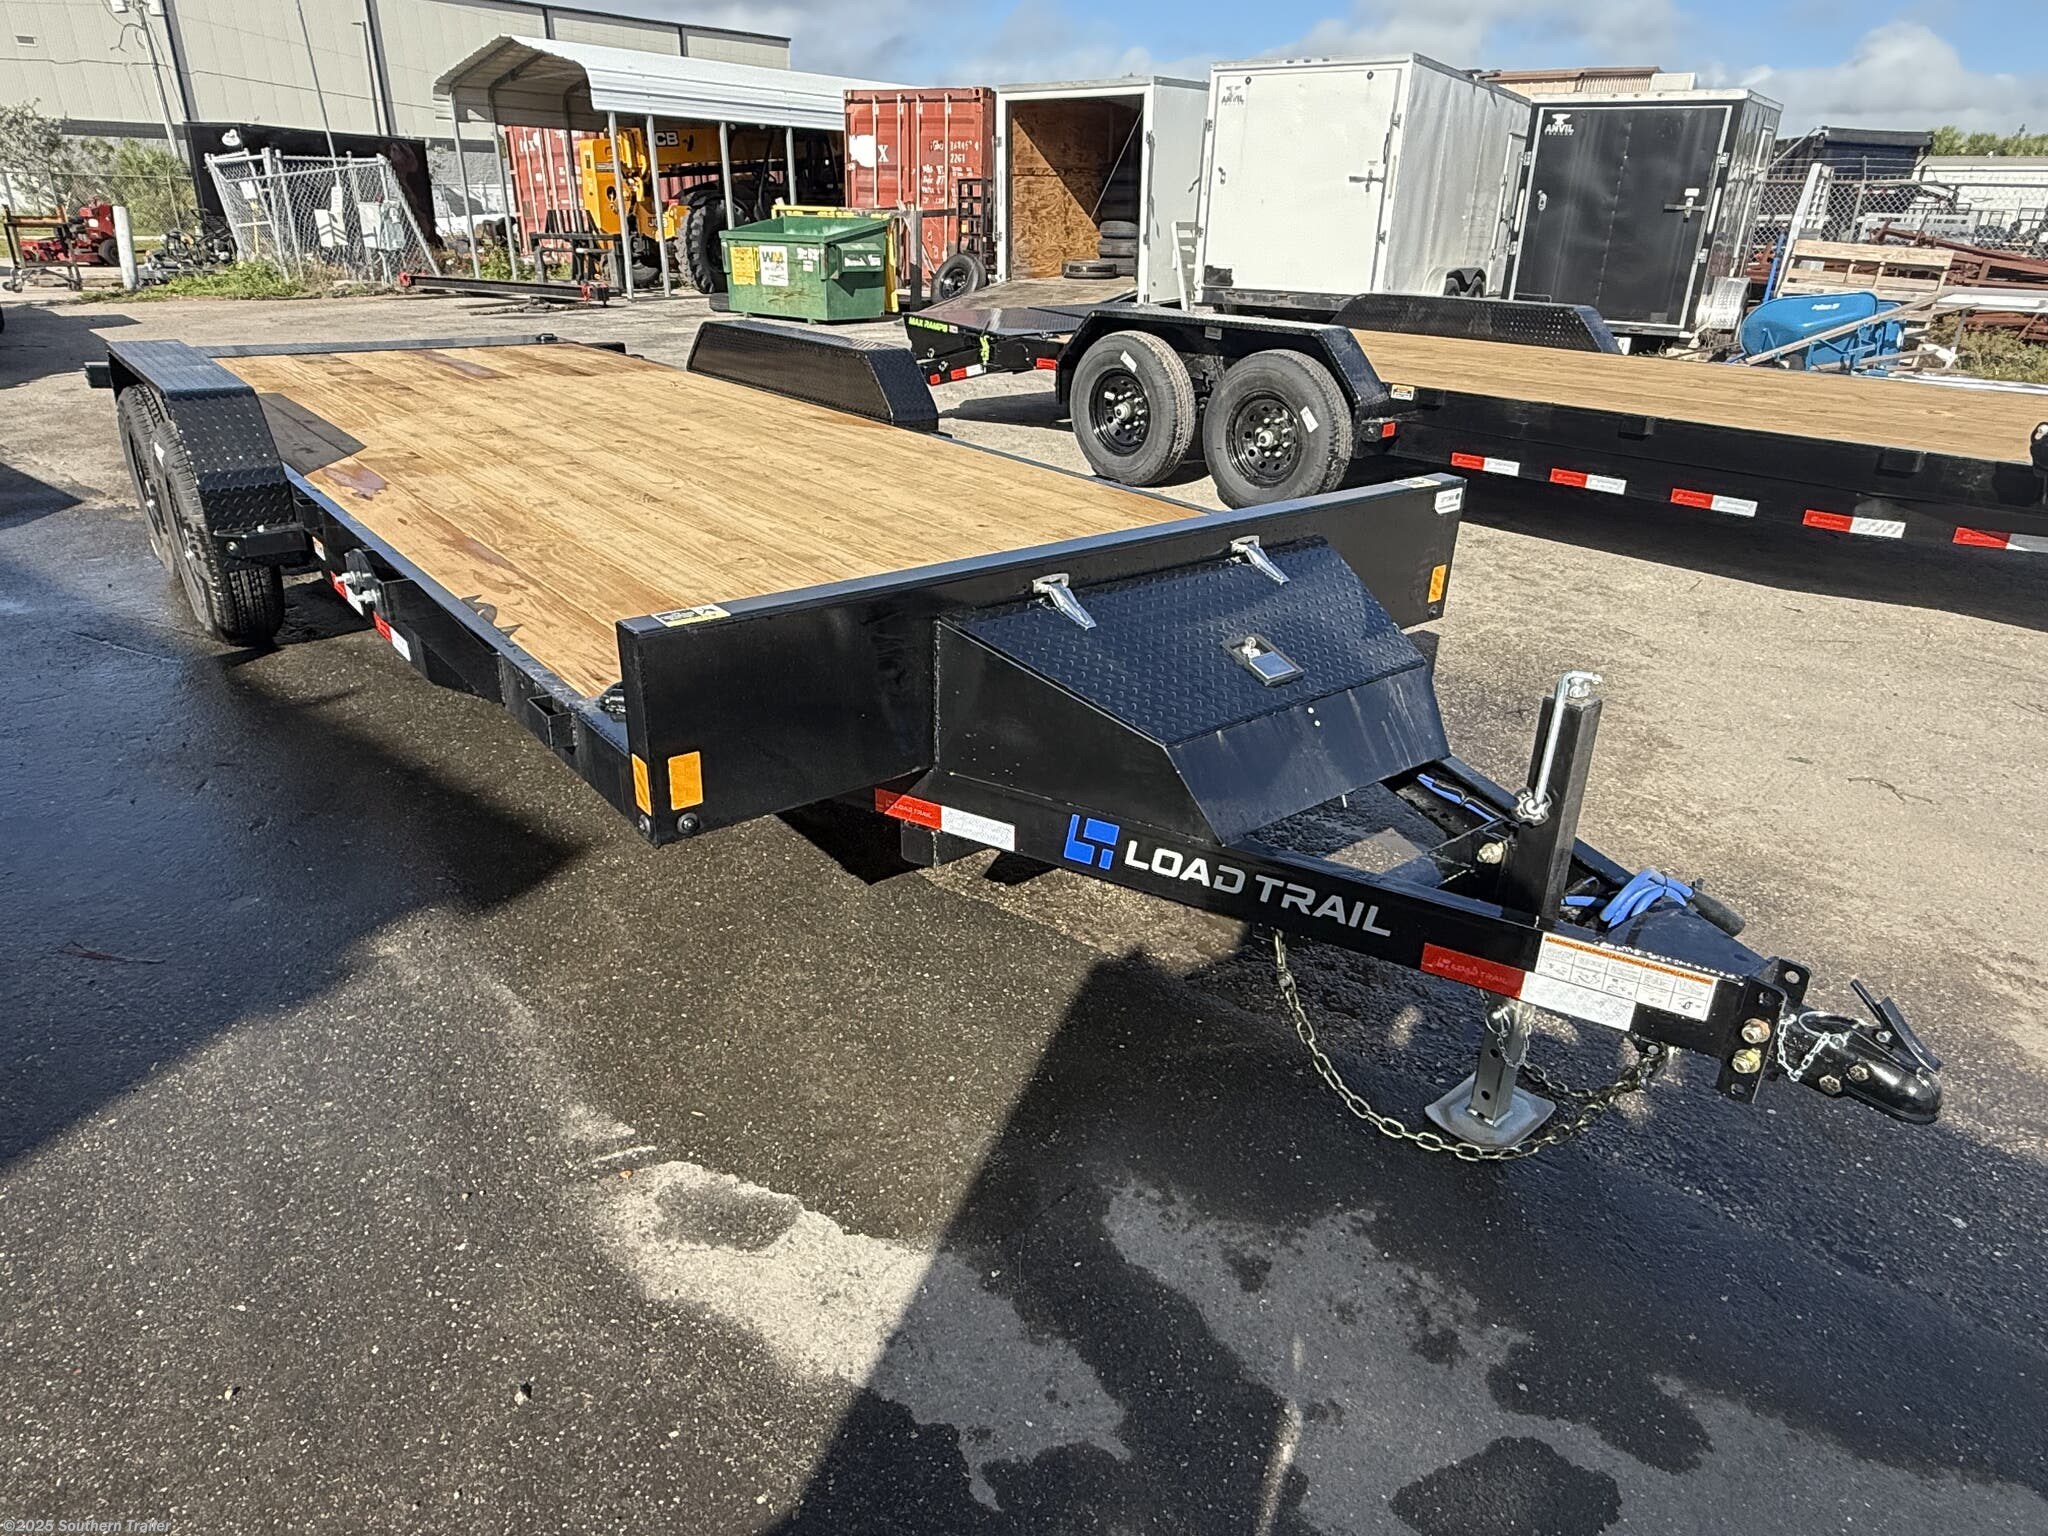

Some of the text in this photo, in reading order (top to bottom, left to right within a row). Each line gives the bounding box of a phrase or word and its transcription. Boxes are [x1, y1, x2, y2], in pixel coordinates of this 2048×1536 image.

[1544, 124, 1575, 134] ANVIL
[644, 132, 679, 146] CB
[908, 316, 923, 328] MAX
[1124, 840, 1391, 937] LOAD TRAIL
